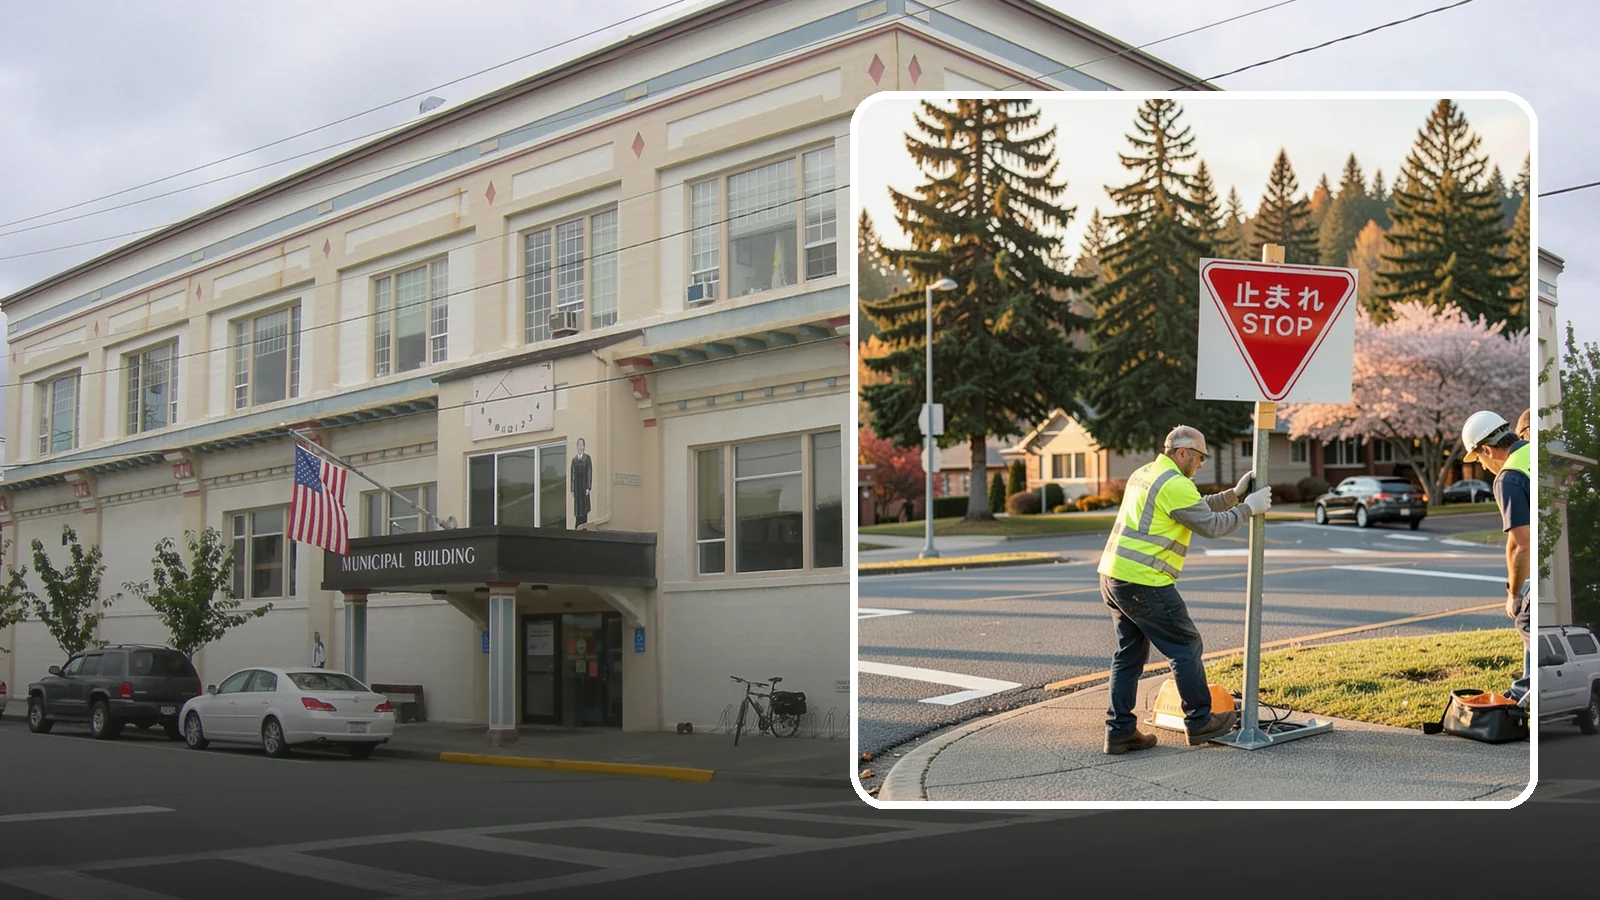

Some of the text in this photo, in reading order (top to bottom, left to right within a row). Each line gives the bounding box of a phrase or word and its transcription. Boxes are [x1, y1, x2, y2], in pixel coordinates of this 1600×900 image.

[1233, 281, 1324, 312] 止まれ
[1242, 312, 1313, 337] STOP
[475, 389, 480, 398] 7
[536, 402, 540, 410] 4
[480, 407, 485, 415] 8
[487, 417, 493, 426] 9
[528, 413, 533, 422] 3
[494, 423, 500, 432] 10
[521, 420, 526, 428] 2
[501, 425, 506, 433] 11
[507, 425, 513, 433] 12
[342, 546, 475, 572] MUNICIPAL BUILDING
